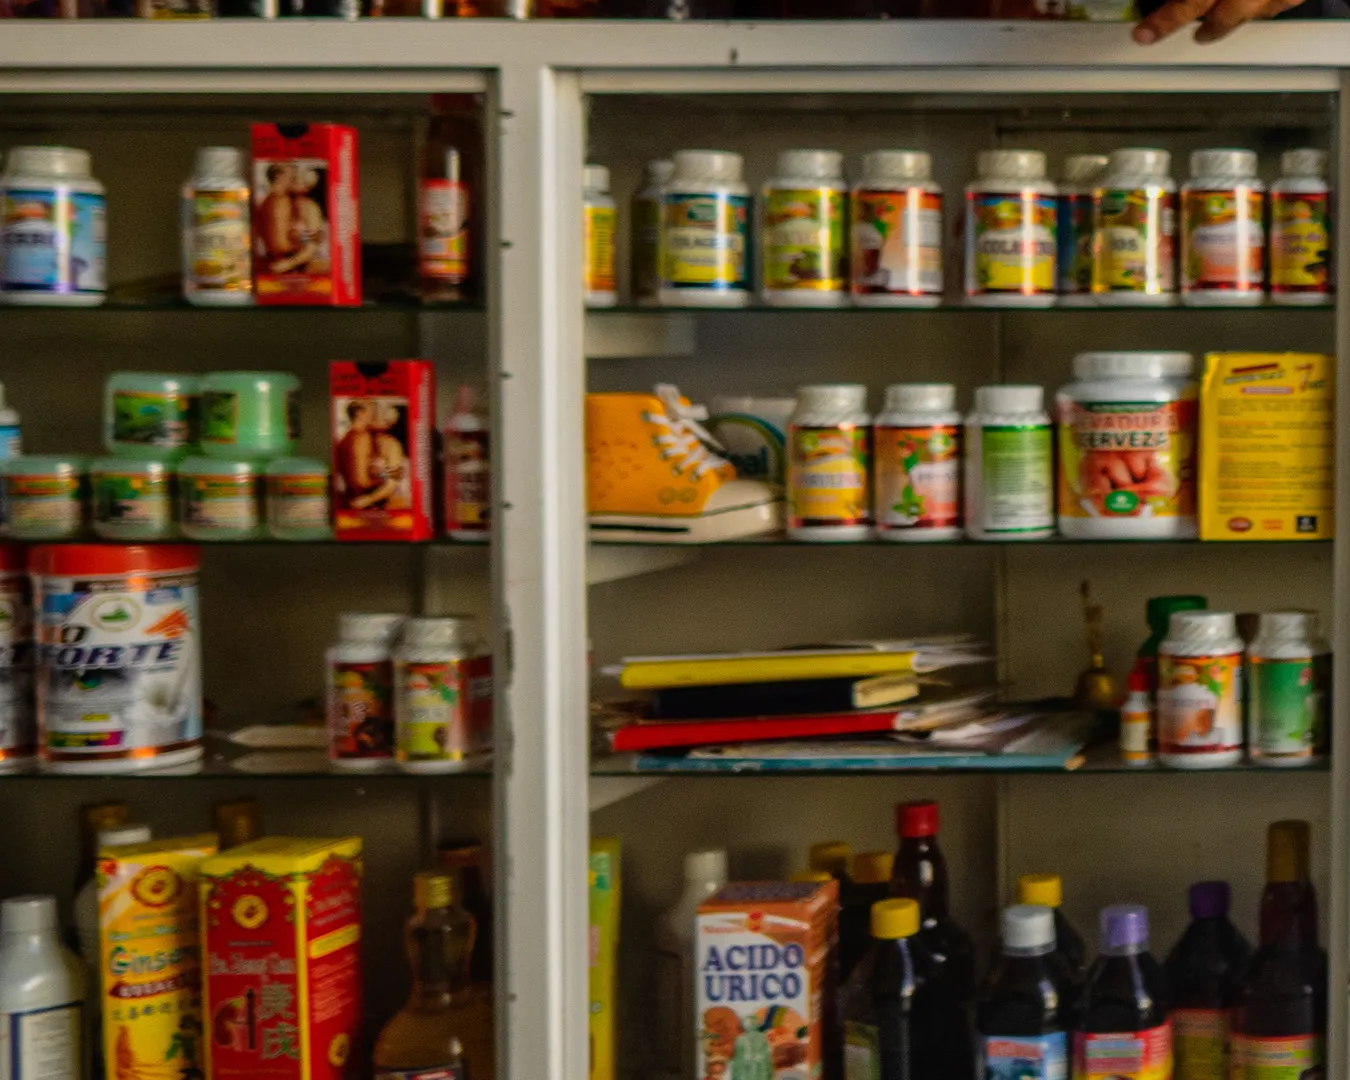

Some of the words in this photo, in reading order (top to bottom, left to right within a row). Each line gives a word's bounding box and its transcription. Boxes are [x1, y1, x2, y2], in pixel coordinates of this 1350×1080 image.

[1077, 431, 1167, 448] CERVEZA
[703, 944, 804, 971] ACIDO
[705, 973, 802, 1001] URICO
